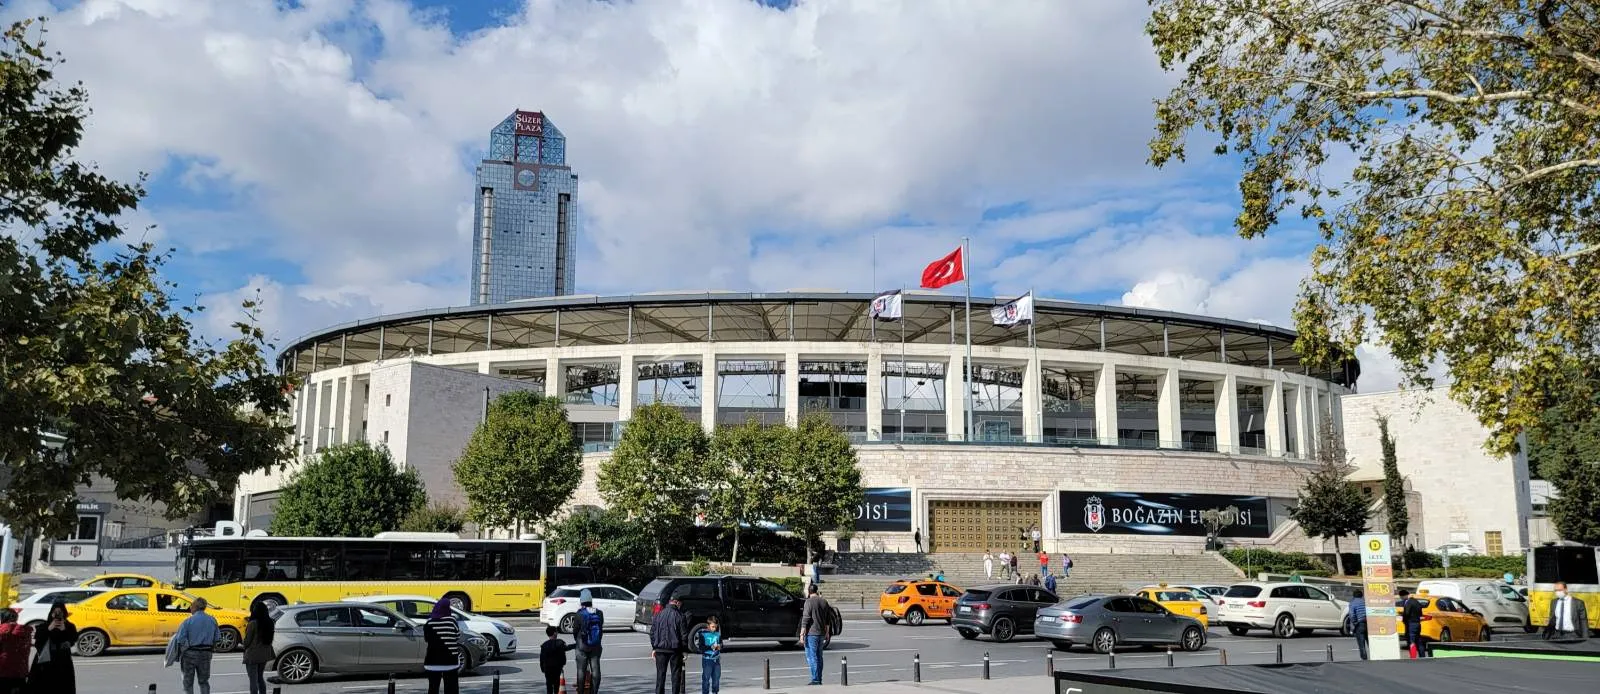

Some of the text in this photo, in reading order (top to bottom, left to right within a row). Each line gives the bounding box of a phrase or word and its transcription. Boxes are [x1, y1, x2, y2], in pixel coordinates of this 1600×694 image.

[516, 114, 542, 125] SÜZER
[515, 123, 542, 132] PLAZA
[1112, 506, 1184, 524] BOĞAZIN
